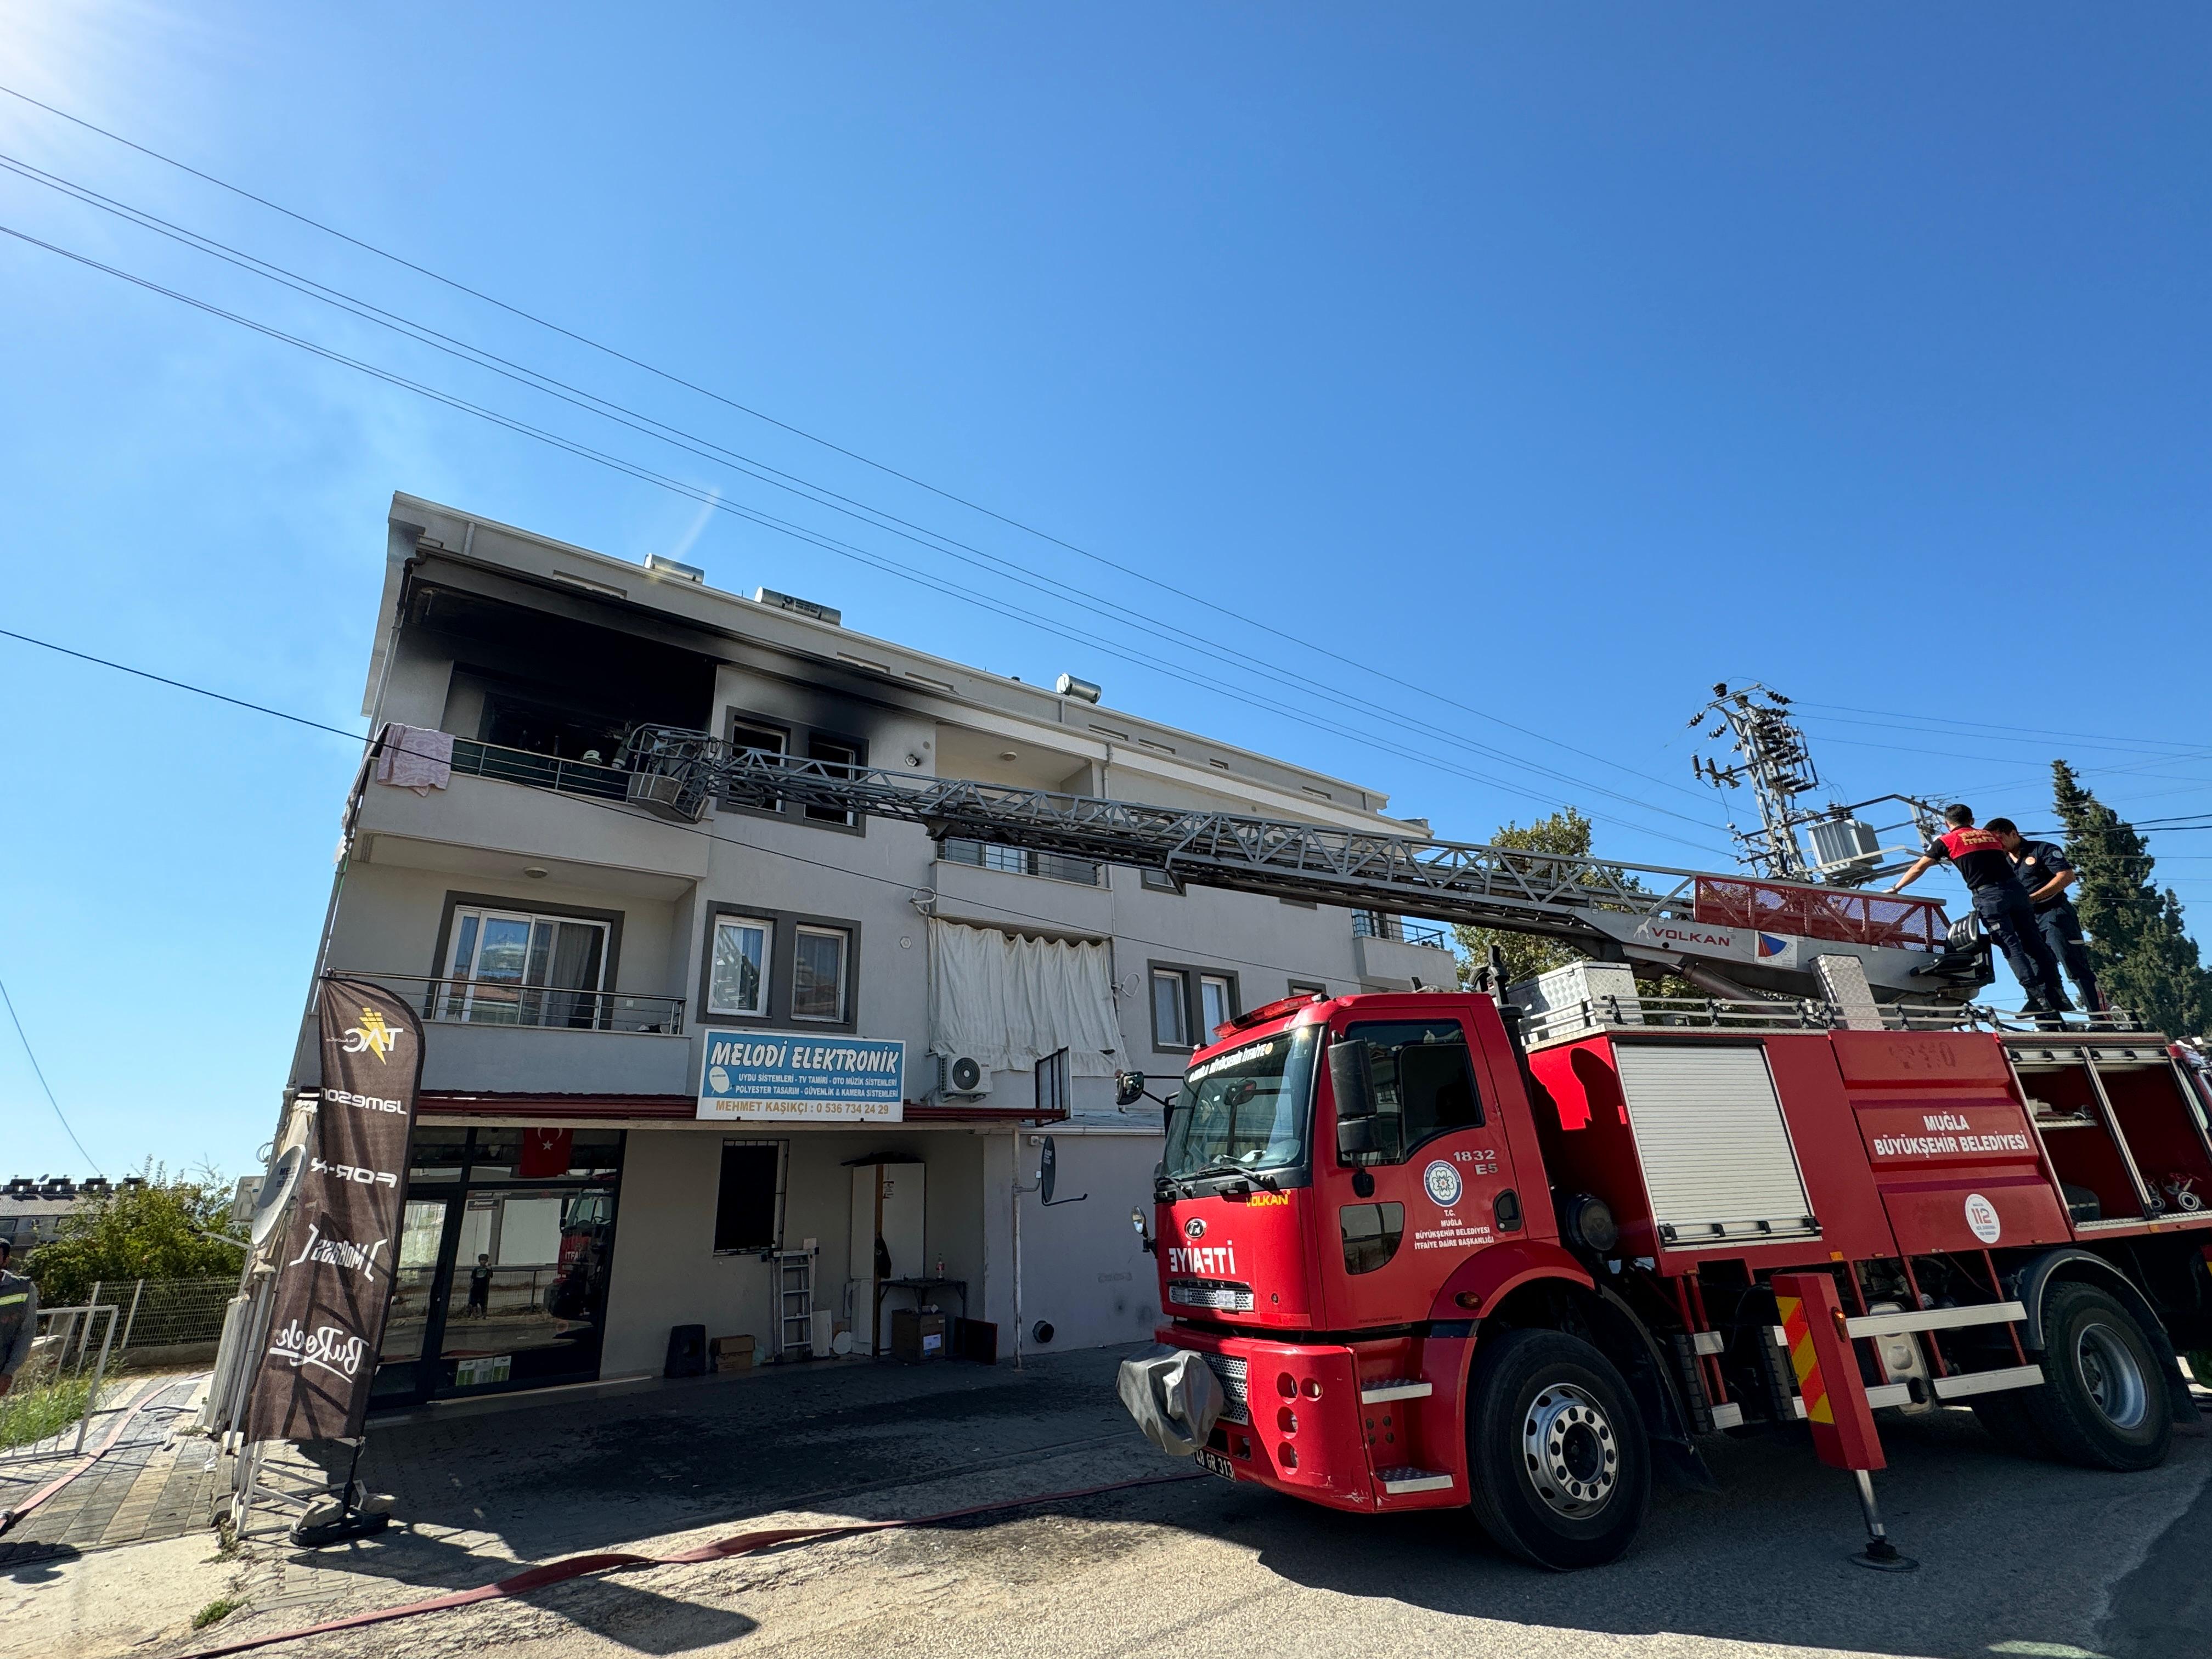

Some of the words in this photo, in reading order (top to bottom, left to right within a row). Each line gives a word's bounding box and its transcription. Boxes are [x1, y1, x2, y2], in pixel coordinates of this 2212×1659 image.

[1651, 927, 1730, 947] VOLKAN
[710, 1040, 788, 1068] MELODİ
[792, 1045, 900, 1074] ELEKTRONİK
[739, 1073, 757, 1082] UYDU
[758, 1072, 794, 1083] SİSTEMLERİ
[799, 1075, 808, 1084] TV
[808, 1075, 828, 1084] TAMİRİ
[845, 1076, 864, 1085] MÜZİK
[865, 1076, 898, 1086] SİSTEMLERİ
[736, 1085, 772, 1094] POLYESTER
[773, 1086, 799, 1094] TASARIM
[804, 1086, 834, 1096] GÜVENLİK
[835, 1088, 840, 1096] &
[841, 1088, 865, 1097] KAMERA
[866, 1087, 898, 1097] SİSTEMLERİ
[716, 1100, 762, 1111] MEHMET
[765, 1102, 808, 1115] KAŞIKÇI
[816, 1103, 822, 1113] 0
[825, 1103, 842, 1114] 536
[845, 1103, 861, 1114] 734
[865, 1104, 875, 1114] 24
[878, 1104, 889, 1114] 29
[1922, 1111, 1971, 1132] MUĞLA
[1874, 1132, 1959, 1158] BÜYÜKŞEHİR
[1960, 1130, 2029, 1152] BELEDİYESİ
[1453, 1149, 1496, 1162] 1832
[1475, 1163, 1498, 1175] E5
[1246, 1194, 1289, 1207] VOLKAN
[1441, 1218, 1462, 1227] MUĞLA
[1971, 1208, 1992, 1224] 112
[1415, 1227, 1454, 1239] BÜYÜKŞEHİR
[1455, 1224, 1491, 1235] BELEDİYESİ
[1414, 1240, 1438, 1250] İTFAİYE
[1438, 1238, 1458, 1248] DAİRE
[1458, 1234, 1494, 1247] BAŞKANLIĞI
[1196, 1449, 1205, 1466] 48
[1206, 1453, 1217, 1472] GR
[1218, 1457, 1234, 1479] 313
